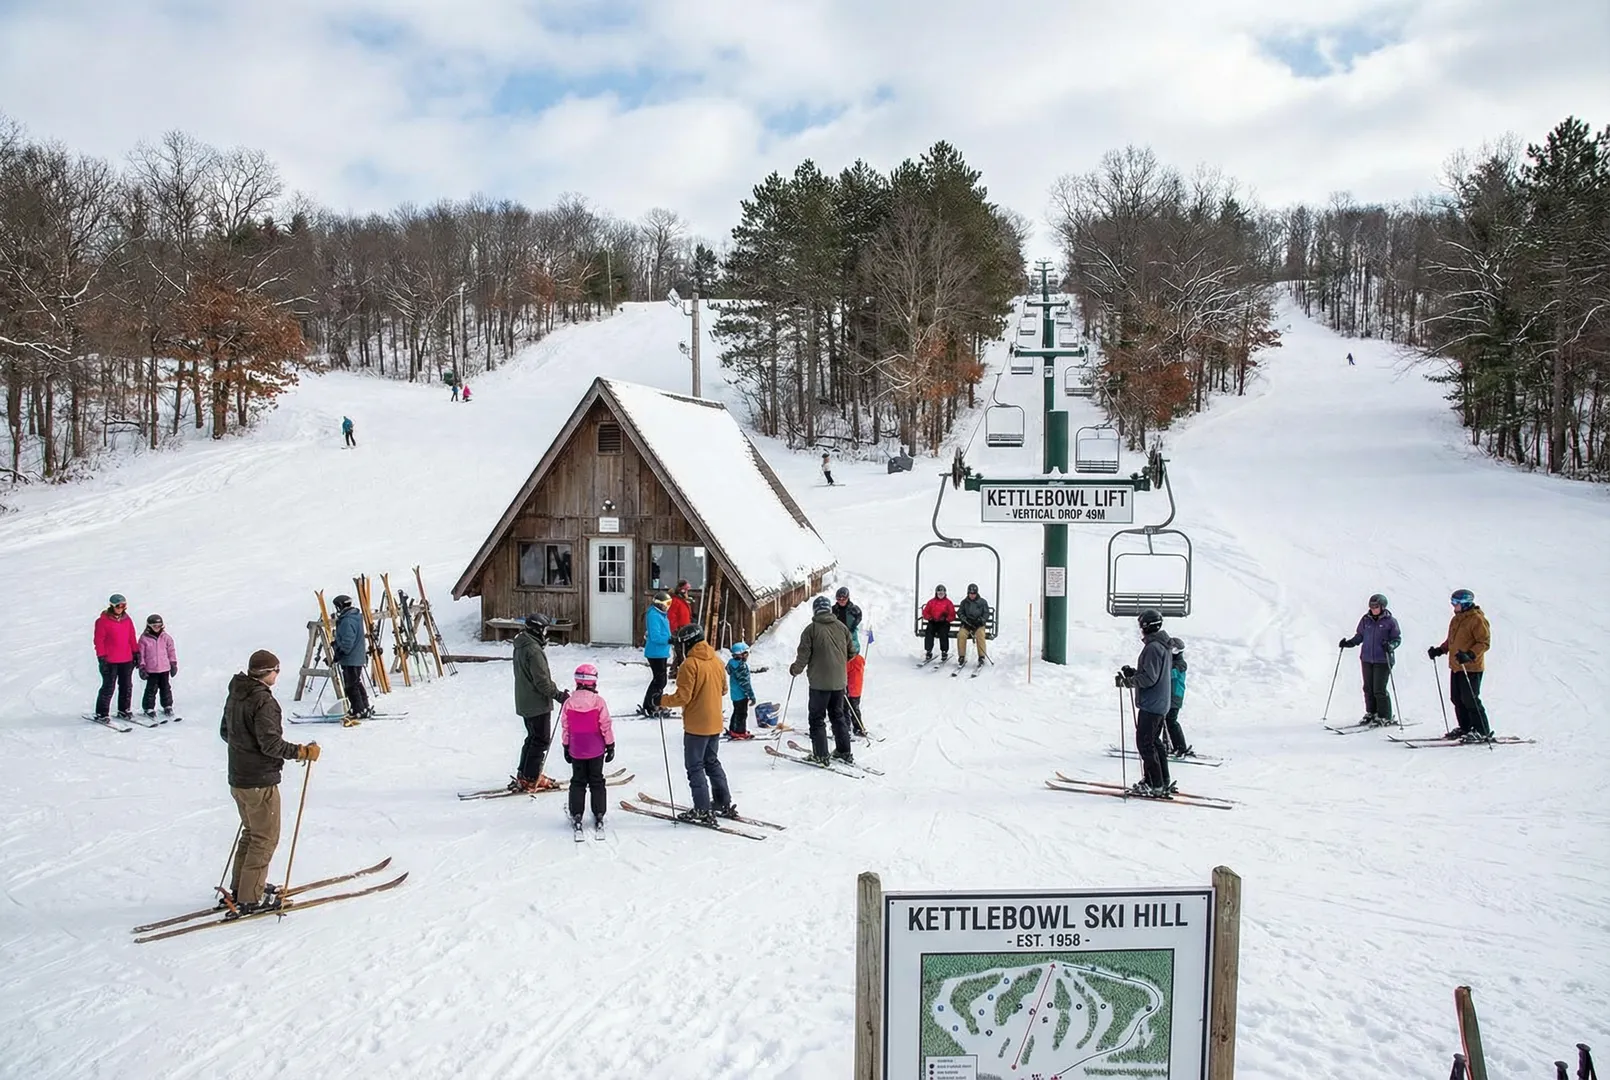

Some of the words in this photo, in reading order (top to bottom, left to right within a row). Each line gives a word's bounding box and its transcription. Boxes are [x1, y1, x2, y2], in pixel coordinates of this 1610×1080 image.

[987, 489, 1089, 507] KETTLEBOWL
[1094, 489, 1128, 507] LIFT
[1011, 508, 1056, 520] VERTICAL
[1057, 508, 1083, 520] DROP
[1085, 508, 1106, 520] 49M
[908, 904, 1076, 931] KETTLEBOWL
[1084, 903, 1125, 929] SKI
[1133, 902, 1189, 928] HILL
[1016, 934, 1044, 948] EST.
[1048, 933, 1081, 947] 1958
